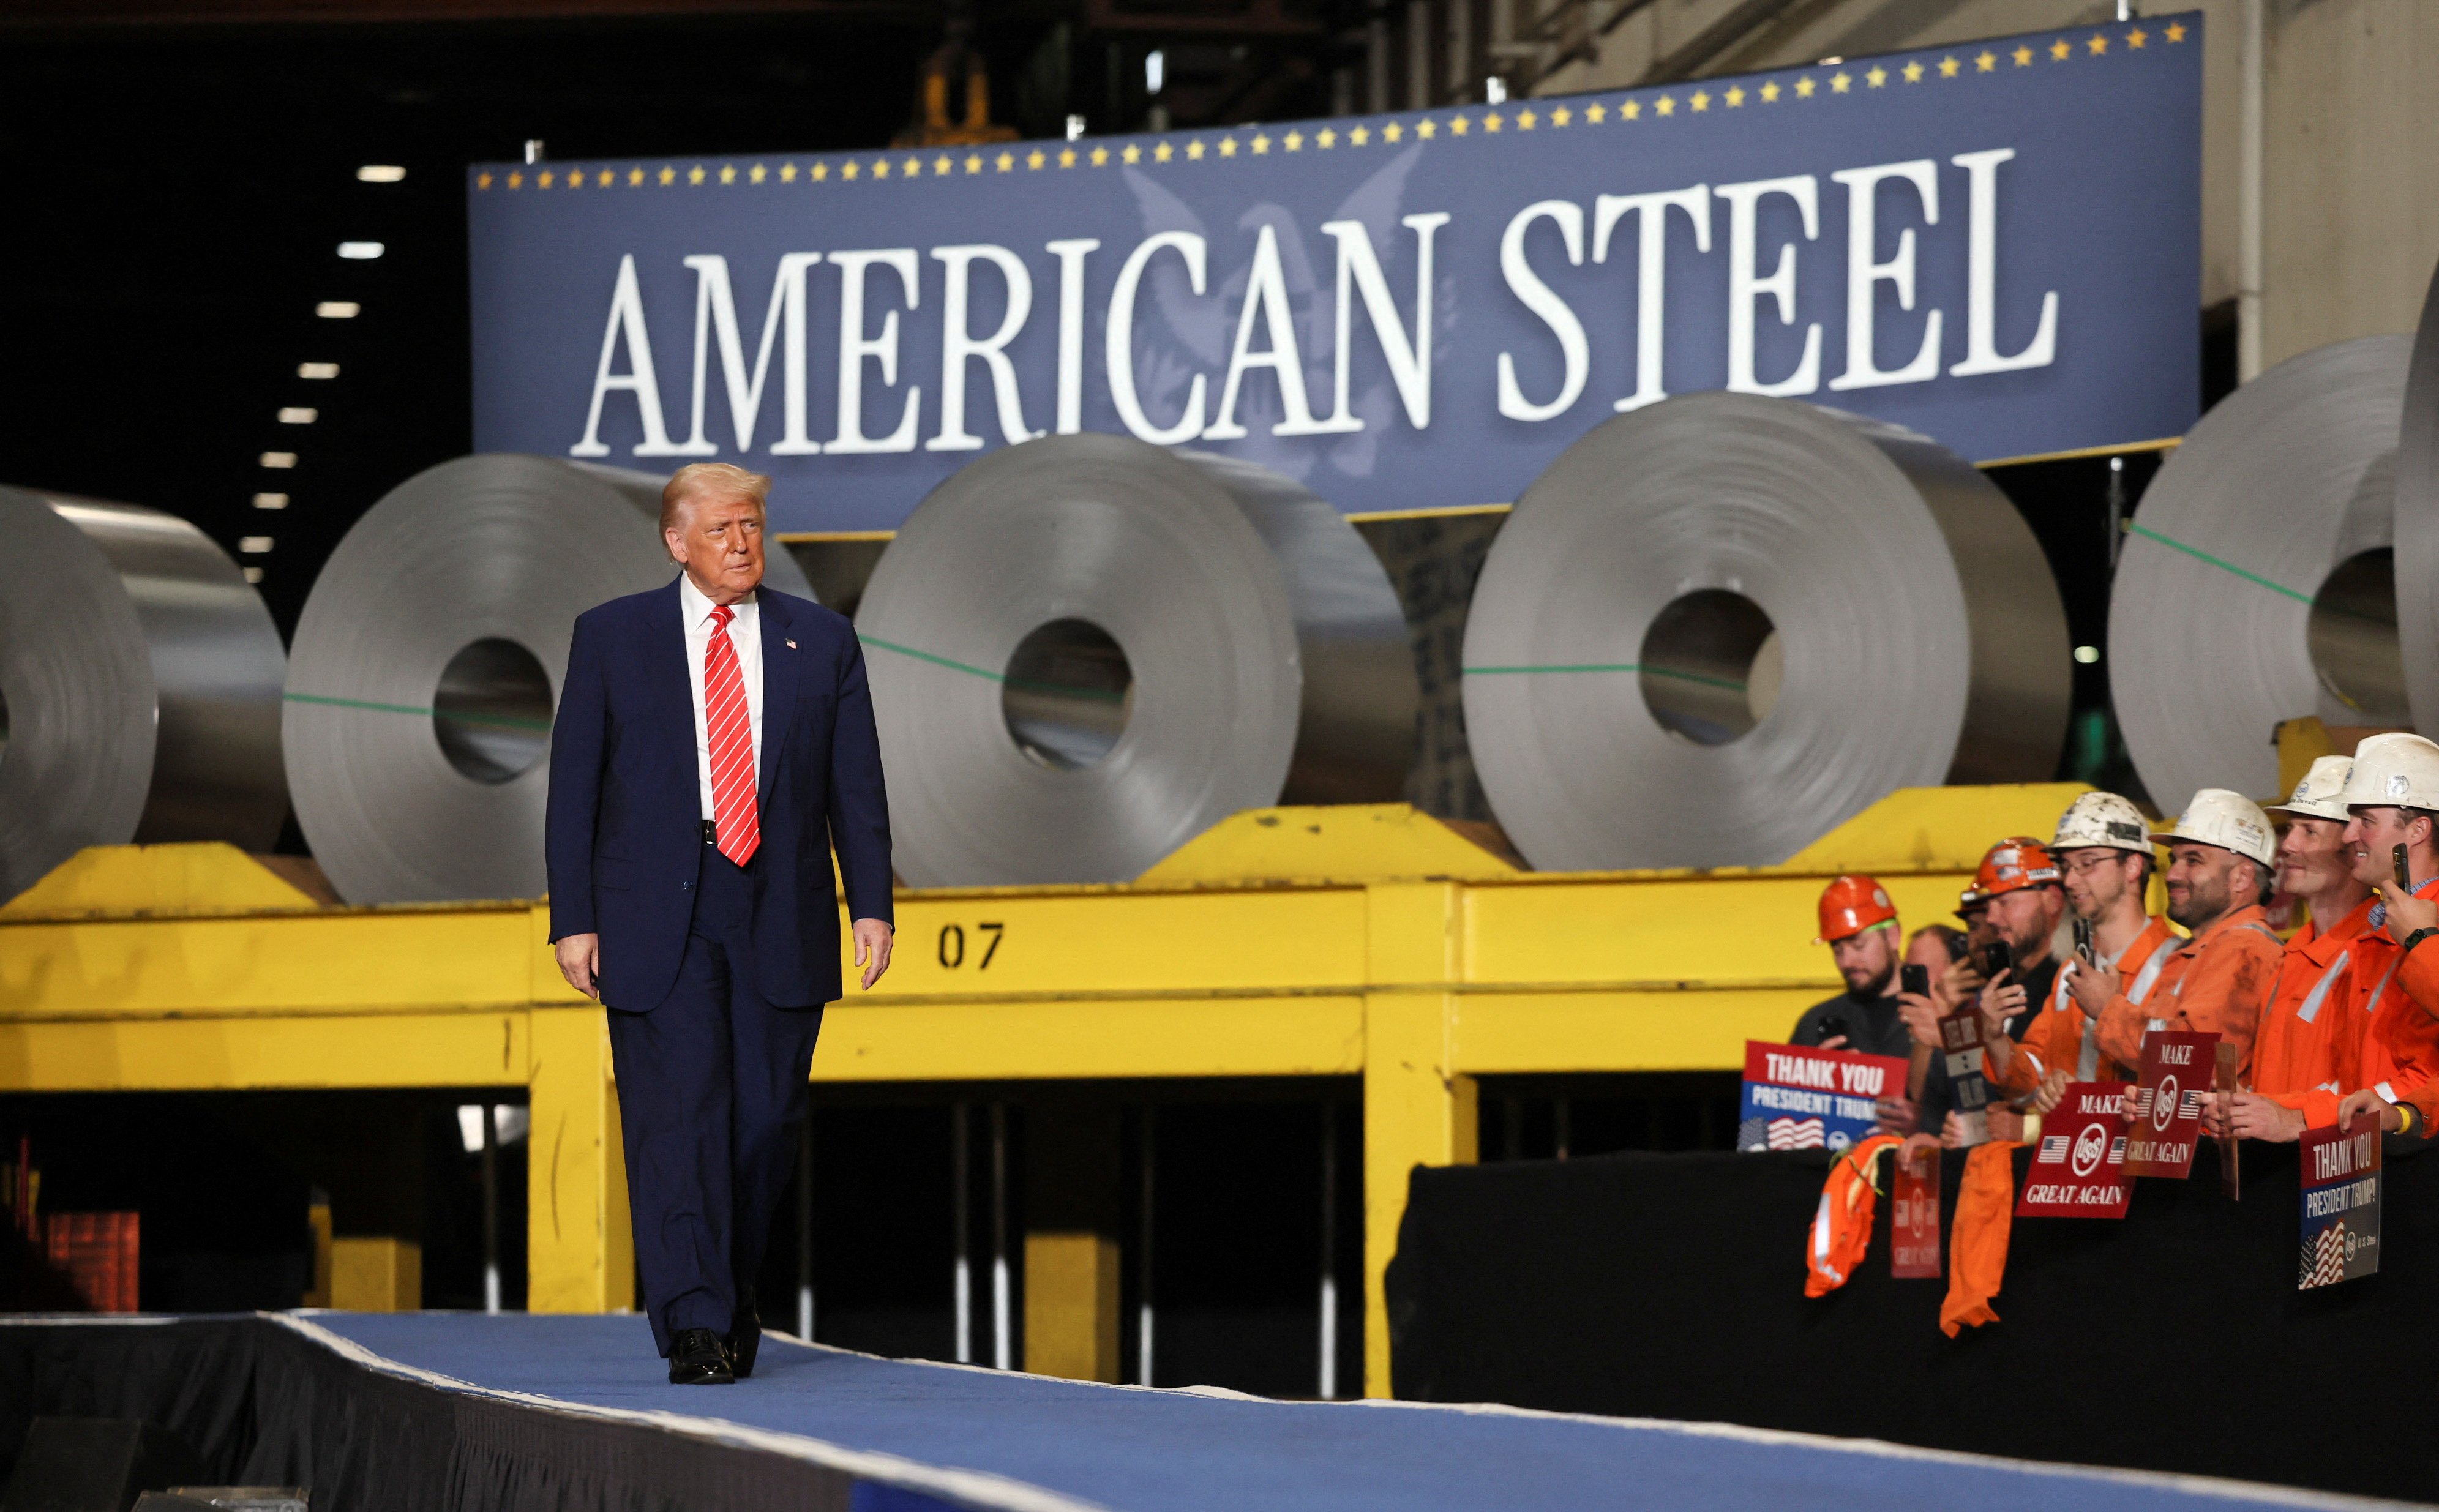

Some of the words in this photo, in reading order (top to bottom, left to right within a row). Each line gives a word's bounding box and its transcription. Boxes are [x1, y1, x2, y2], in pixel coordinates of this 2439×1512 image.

[570, 212, 1451, 456] AMERICAN
[1497, 148, 2058, 422] STEEL
[939, 922, 1003, 970] 07
[1766, 1053, 1837, 1090] THANK
[1840, 1062, 1885, 1095] YOU
[2159, 1044, 2194, 1065] MAKE
[1752, 1084, 1832, 1116] PRESIDENT
[1835, 1096, 1877, 1121] TRUM
[2077, 1095, 2125, 1114] MAKE
[2127, 1141, 2157, 1161] GREAT
[2155, 1142, 2190, 1163] AGAIN
[2313, 1137, 2351, 1180] THANK
[2354, 1132, 2371, 1170] YOU
[2026, 1184, 2078, 1204] GREAT
[2075, 1185, 2124, 1205] AGAIN
[2307, 1185, 2350, 1218] PRESIDENT
[2351, 1177, 2376, 1208] TRUMP!
